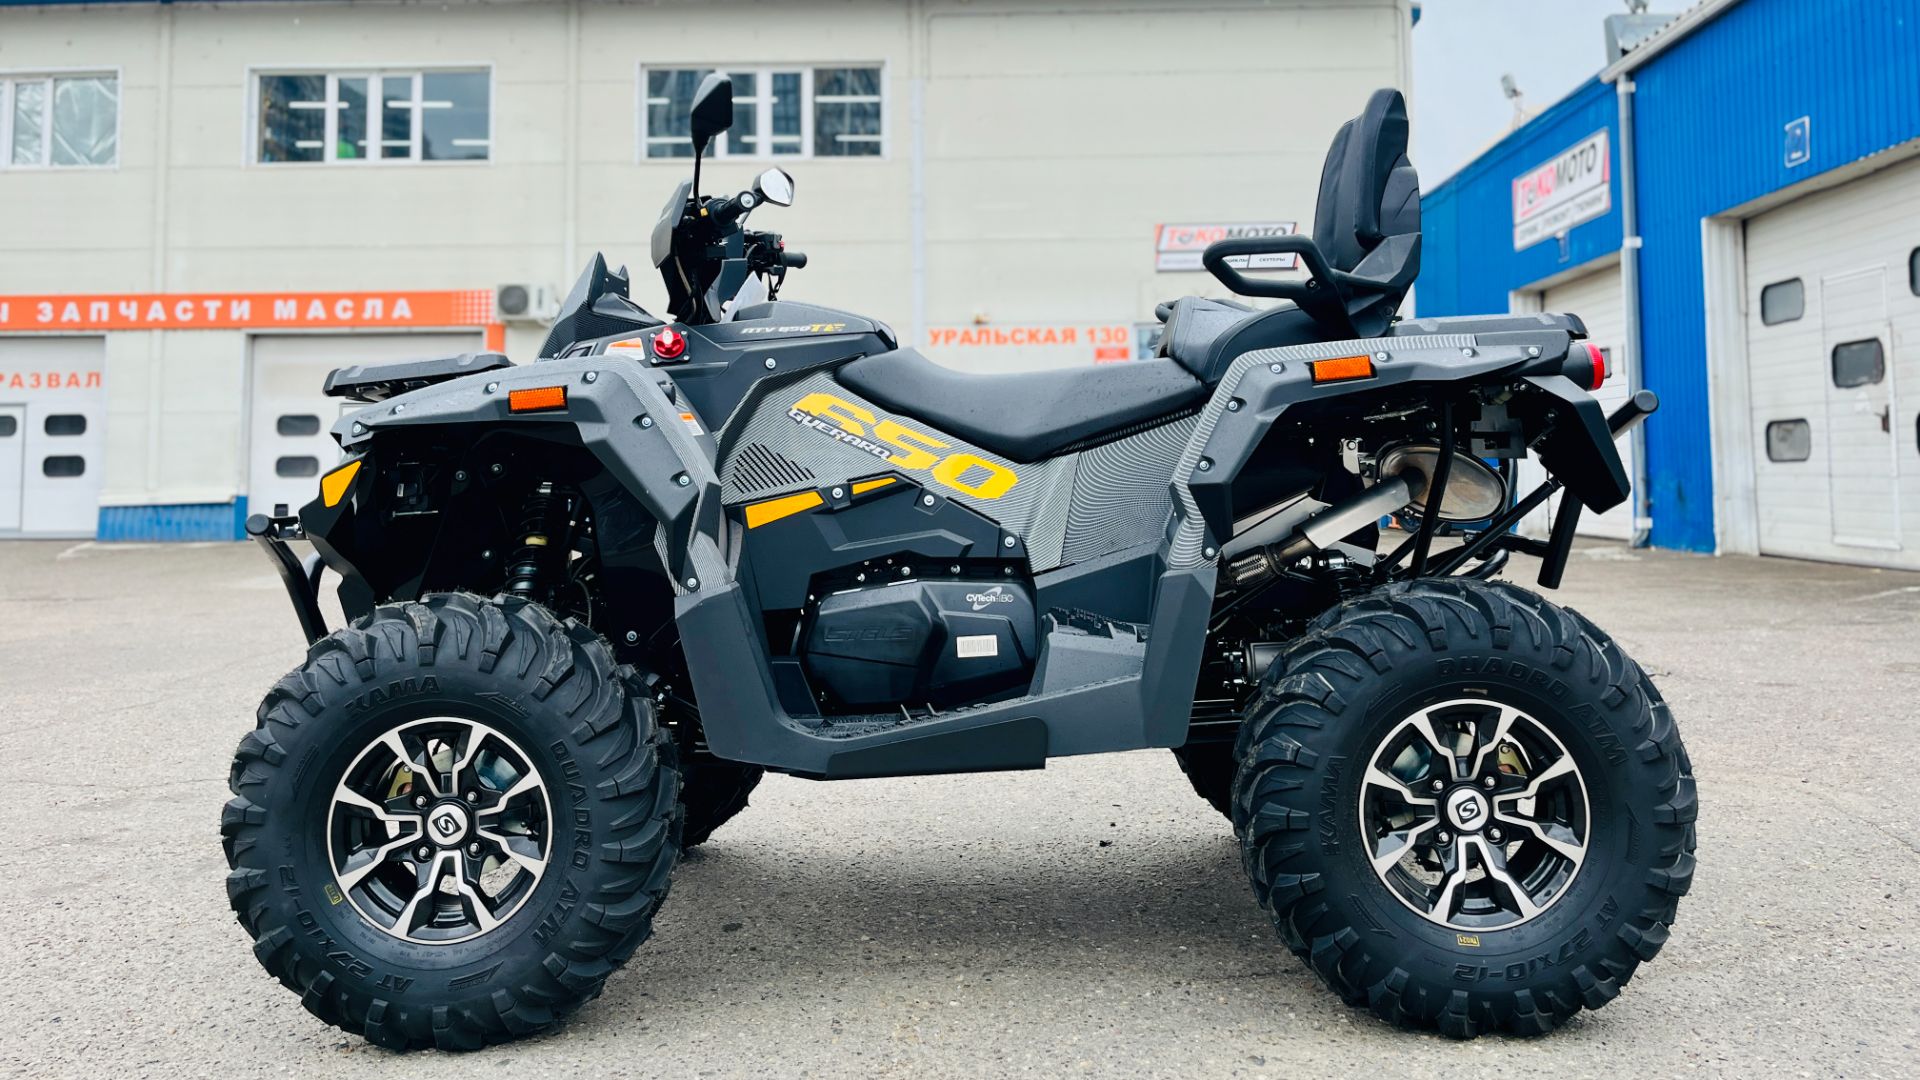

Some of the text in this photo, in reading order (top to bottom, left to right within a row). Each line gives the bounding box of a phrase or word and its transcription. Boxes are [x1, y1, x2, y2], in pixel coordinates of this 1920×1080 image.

[36, 299, 251, 323] ЗАПЧАСТИ
[273, 297, 413, 320] МАСЛА
[929, 326, 1128, 346] УРАЛЬСКАЯ 130
[791, 393, 1019, 499] 650
[528, 737, 593, 949] QUADRO ATM
